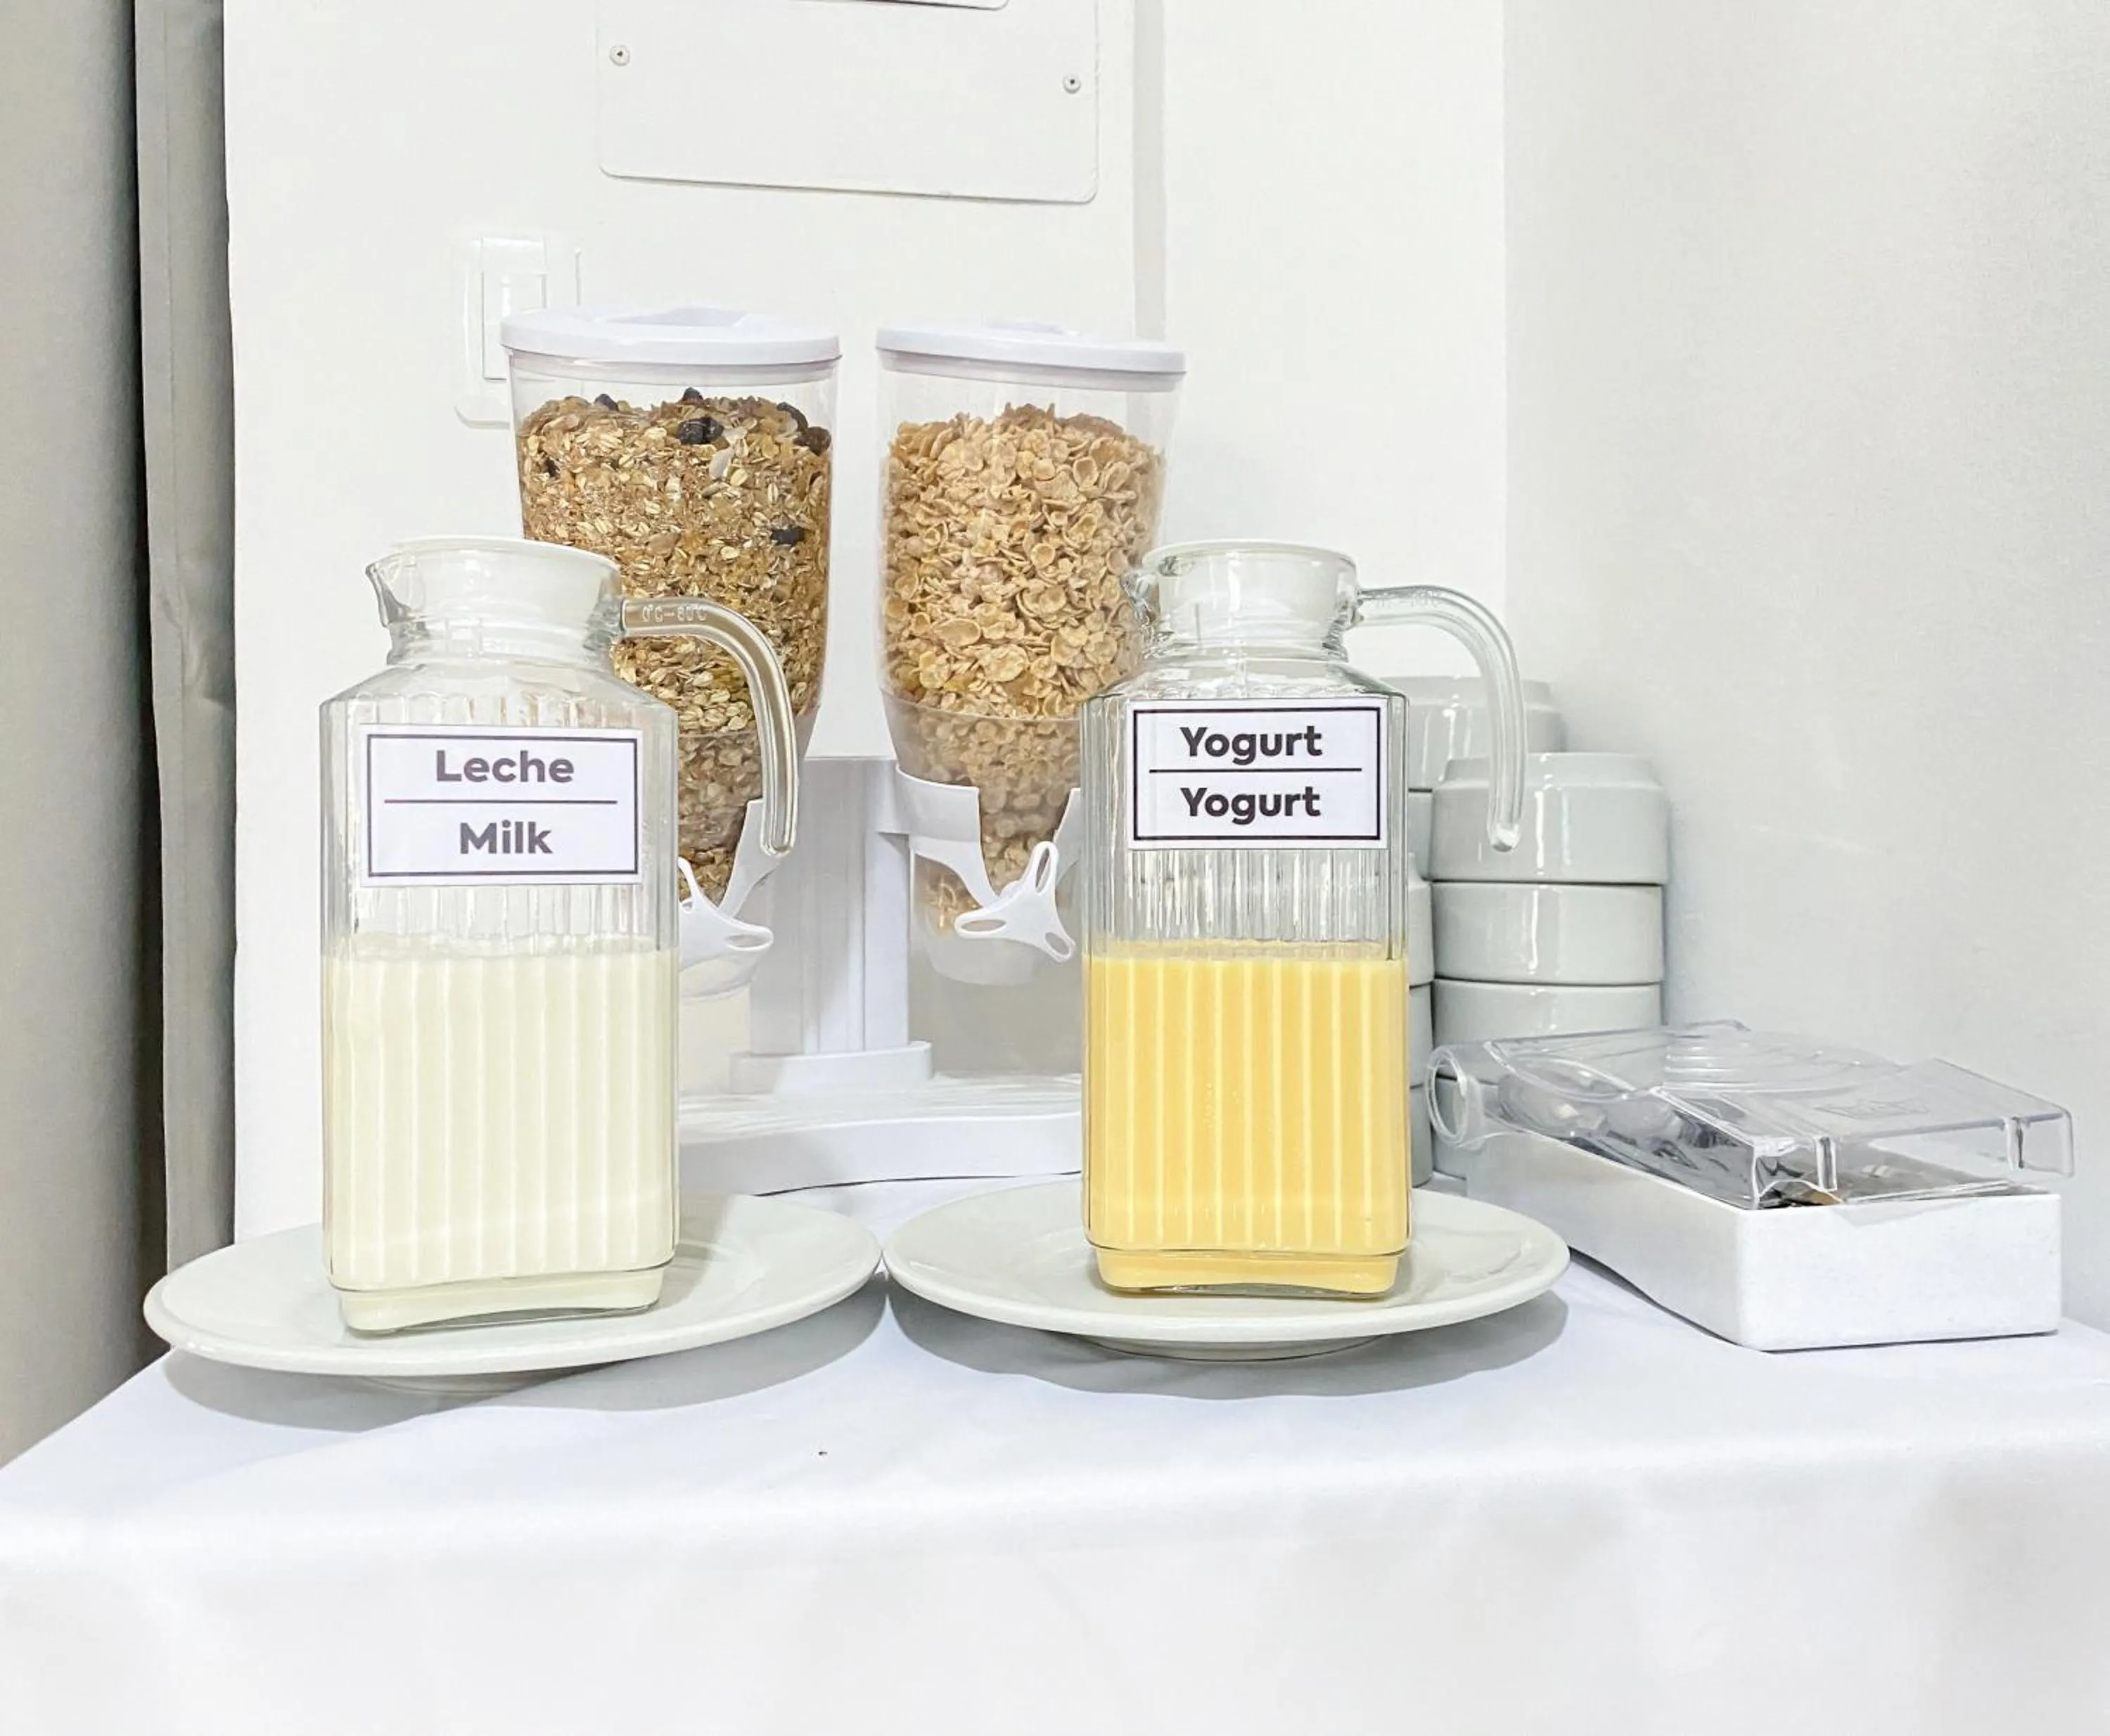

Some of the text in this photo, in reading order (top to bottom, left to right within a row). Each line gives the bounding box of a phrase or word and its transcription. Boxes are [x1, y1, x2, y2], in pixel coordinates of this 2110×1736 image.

[1179, 725, 1323, 765] Yogurt
[435, 750, 575, 783] Leche
[1180, 786, 1321, 825] Yogurt
[459, 819, 554, 855] Milk
